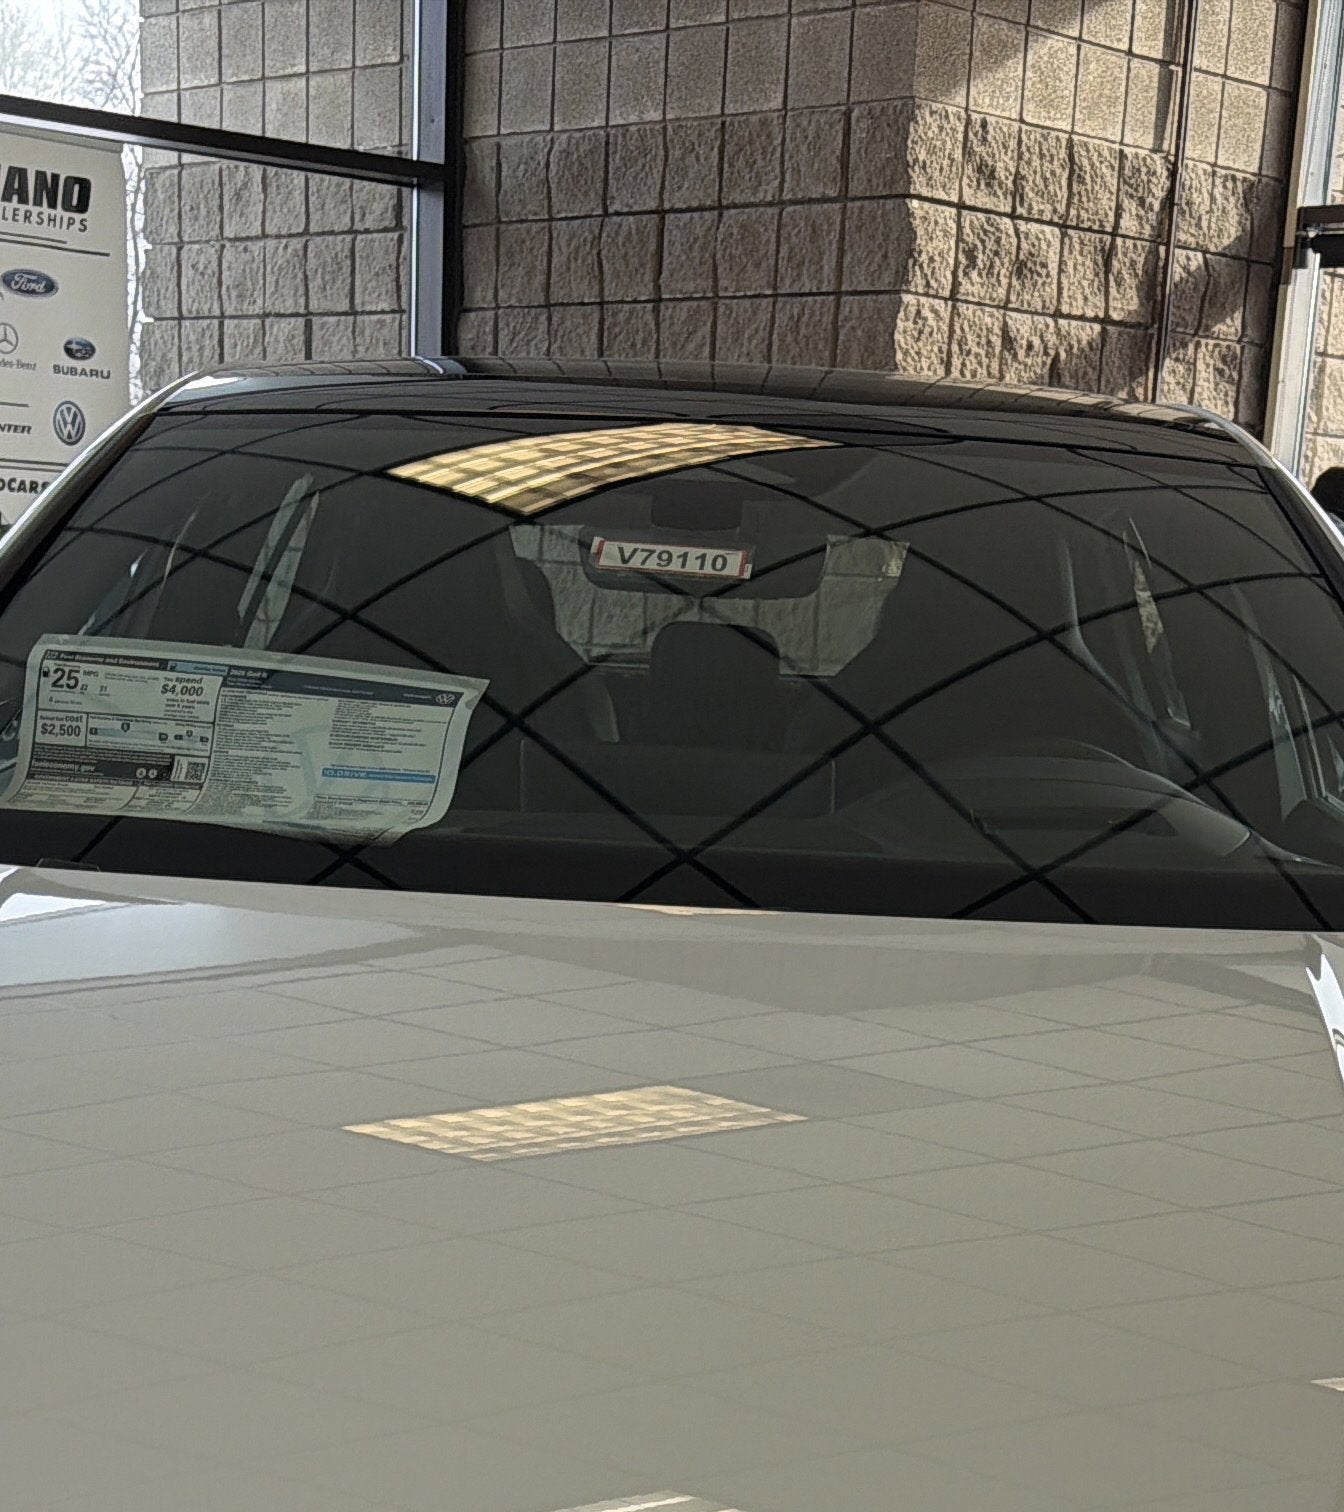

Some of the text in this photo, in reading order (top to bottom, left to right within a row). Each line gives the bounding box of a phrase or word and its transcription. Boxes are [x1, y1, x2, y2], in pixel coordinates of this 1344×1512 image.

[10, 271, 47, 294] Ford
[52, 363, 112, 380] SUBARU
[617, 546, 729, 573] V79110
[50, 667, 81, 691] 25
[82, 669, 99, 678] MPG
[174, 676, 204, 686] spend
[160, 683, 204, 698] $4,000
[64, 714, 84, 723] cost
[40, 722, 82, 737] $2,500
